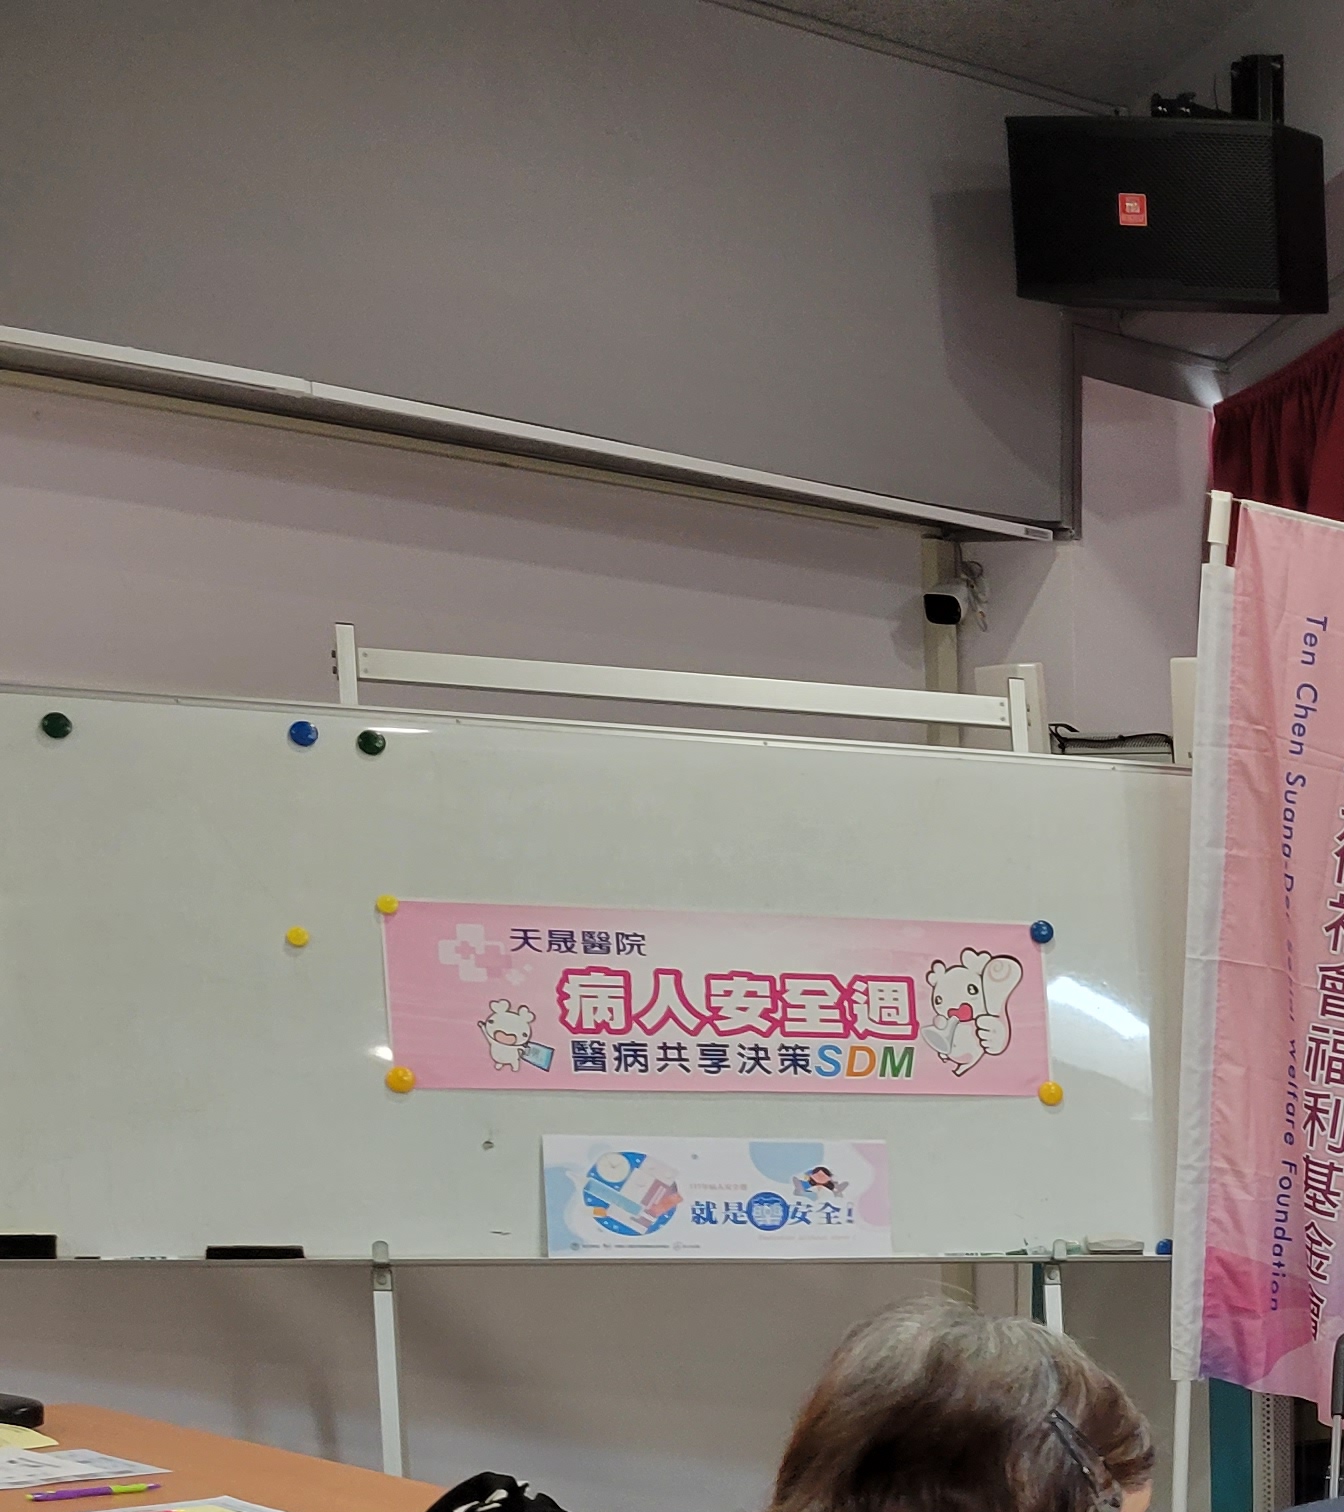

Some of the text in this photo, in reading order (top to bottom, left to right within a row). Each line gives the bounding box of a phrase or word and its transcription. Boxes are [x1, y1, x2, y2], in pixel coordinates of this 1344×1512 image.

[1300, 615, 1328, 667] Ten
[1288, 682, 1318, 756] Chen
[509, 926, 648, 957] 天晟醫院
[556, 966, 920, 1040] 病人安全週
[572, 1039, 915, 1079] 醫病共享決策SDM
[1282, 1036, 1299, 1147] welfare
[1269, 1160, 1298, 1312] Foundation
